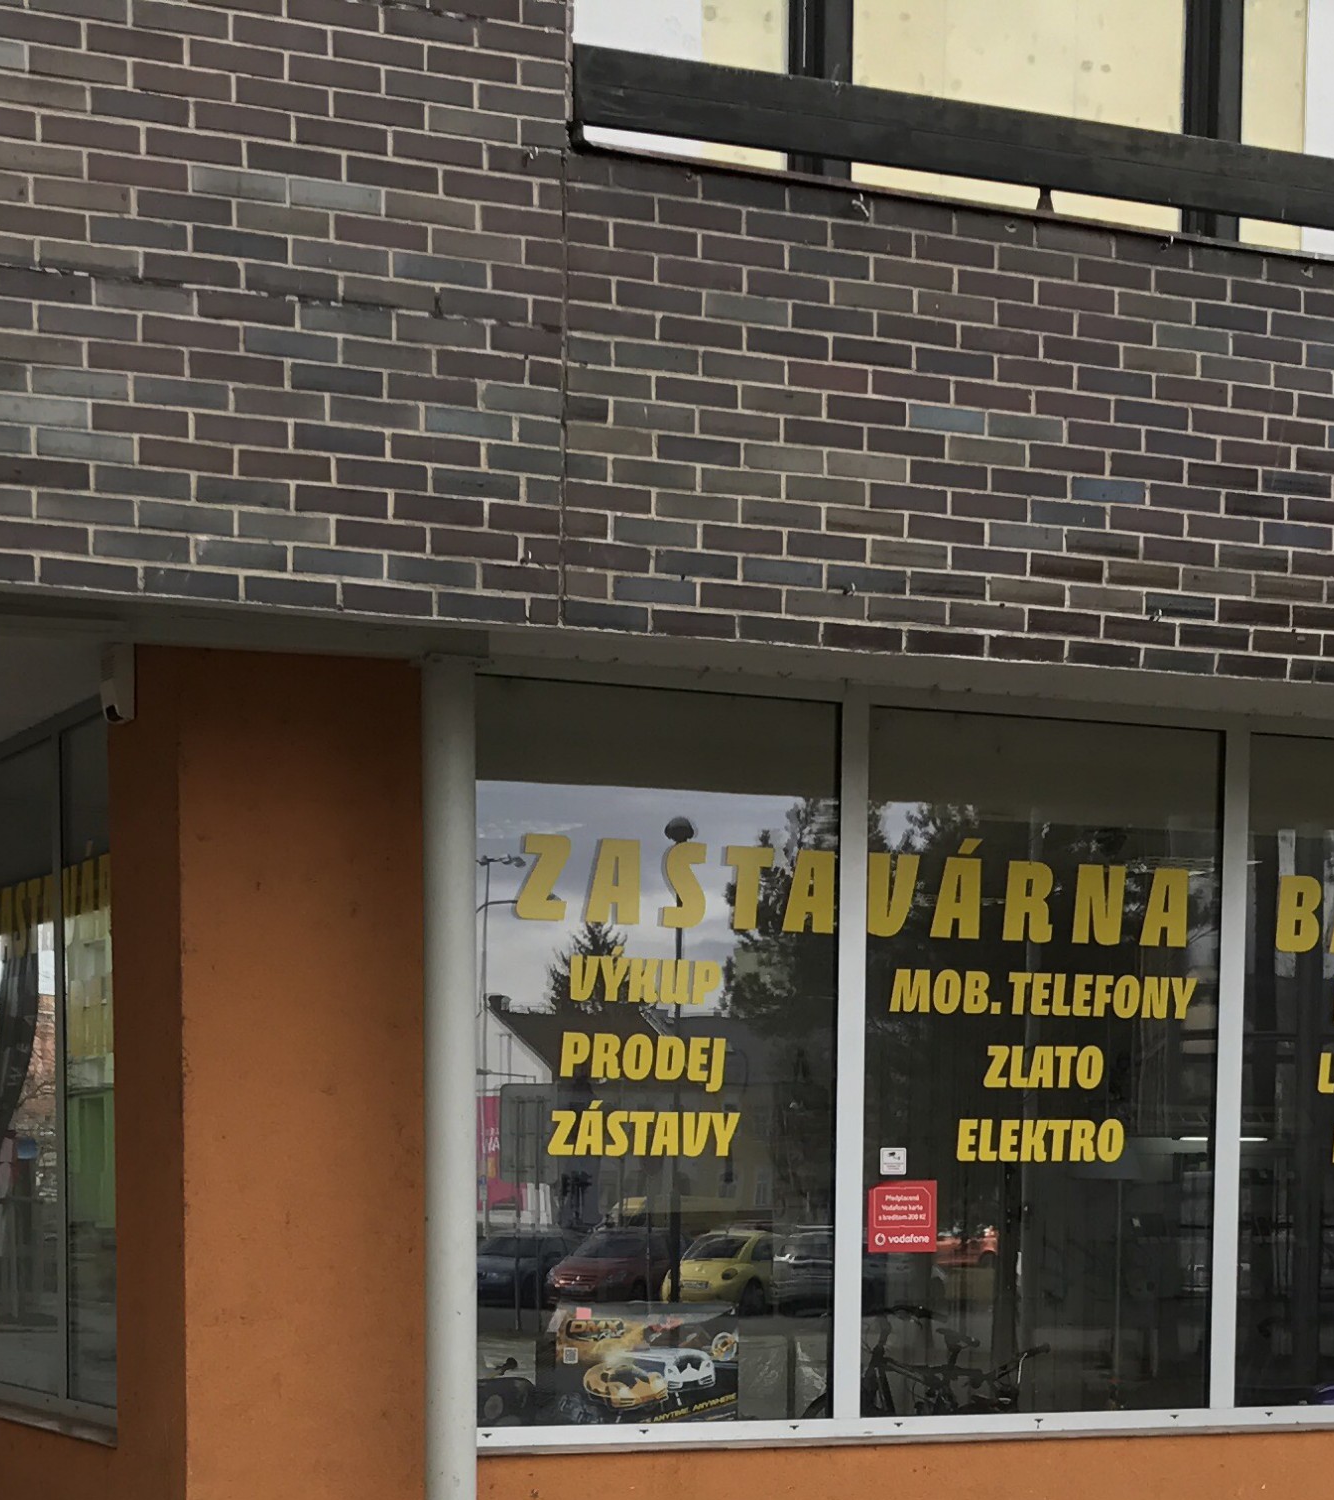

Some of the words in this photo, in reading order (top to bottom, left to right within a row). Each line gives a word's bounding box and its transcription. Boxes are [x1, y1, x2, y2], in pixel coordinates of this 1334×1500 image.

[513, 833, 1189, 948] ZASTAVÁRNA
[569, 946, 723, 1005] VÝKUP
[560, 1031, 737, 1093] PRODEJ
[983, 1045, 1105, 1090] ZLATO
[548, 1100, 742, 1158] ZÁSTAVY
[956, 1118, 1125, 1163] ELEKTRO
[887, 1233, 930, 1243] vodafone
